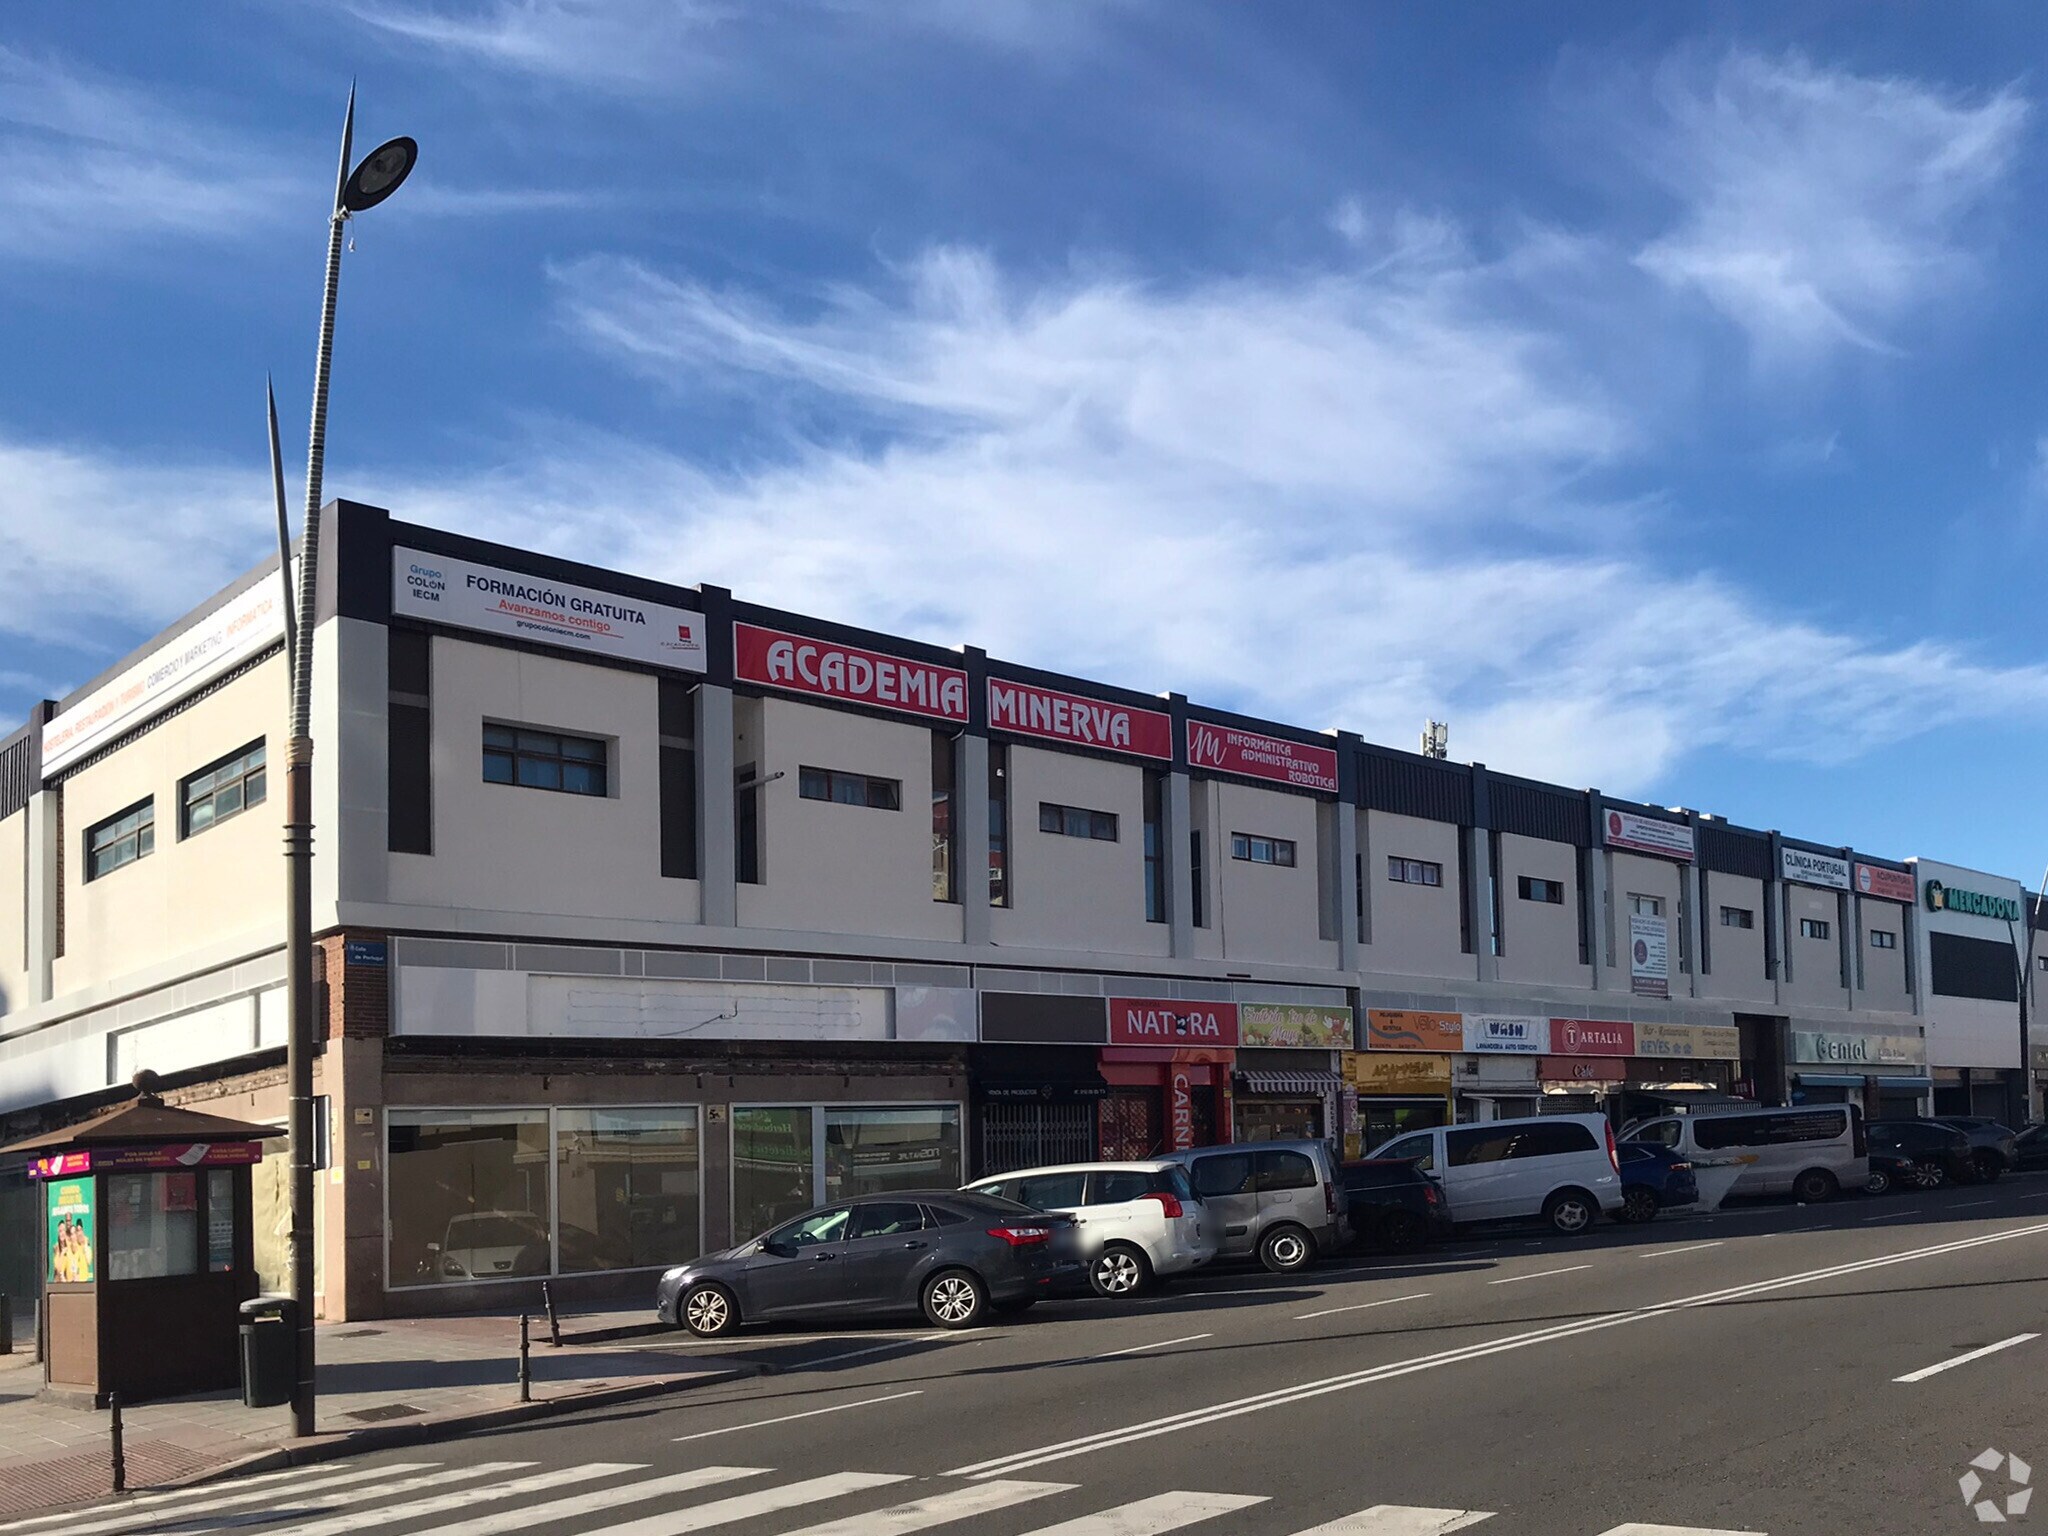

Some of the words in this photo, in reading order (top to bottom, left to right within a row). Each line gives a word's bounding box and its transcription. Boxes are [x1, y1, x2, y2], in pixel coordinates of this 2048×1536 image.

[410, 564, 442, 579] Grupo
[413, 588, 440, 602] IECM
[467, 574, 565, 608] FORMACIÓN
[571, 597, 646, 625] GRATUITA
[499, 599, 565, 623] Avanzamos
[568, 614, 611, 632] contigo
[516, 620, 591, 641] grupocoloniecm.com
[147, 663, 178, 689] COMERCIO
[184, 631, 222, 666] MARKETING
[766, 640, 964, 715] ACADEMIA
[992, 685, 1130, 747] MINERVA
[1227, 732, 1291, 756] INFORMÁTICA
[1241, 749, 1319, 773] ADMINISTRATIVO
[1288, 769, 1335, 789] ROBÓTICA
[1785, 851, 1811, 870] CLÍNICA
[1813, 859, 1847, 877] PORTUGAL
[1641, 1038, 1671, 1054] REYES
